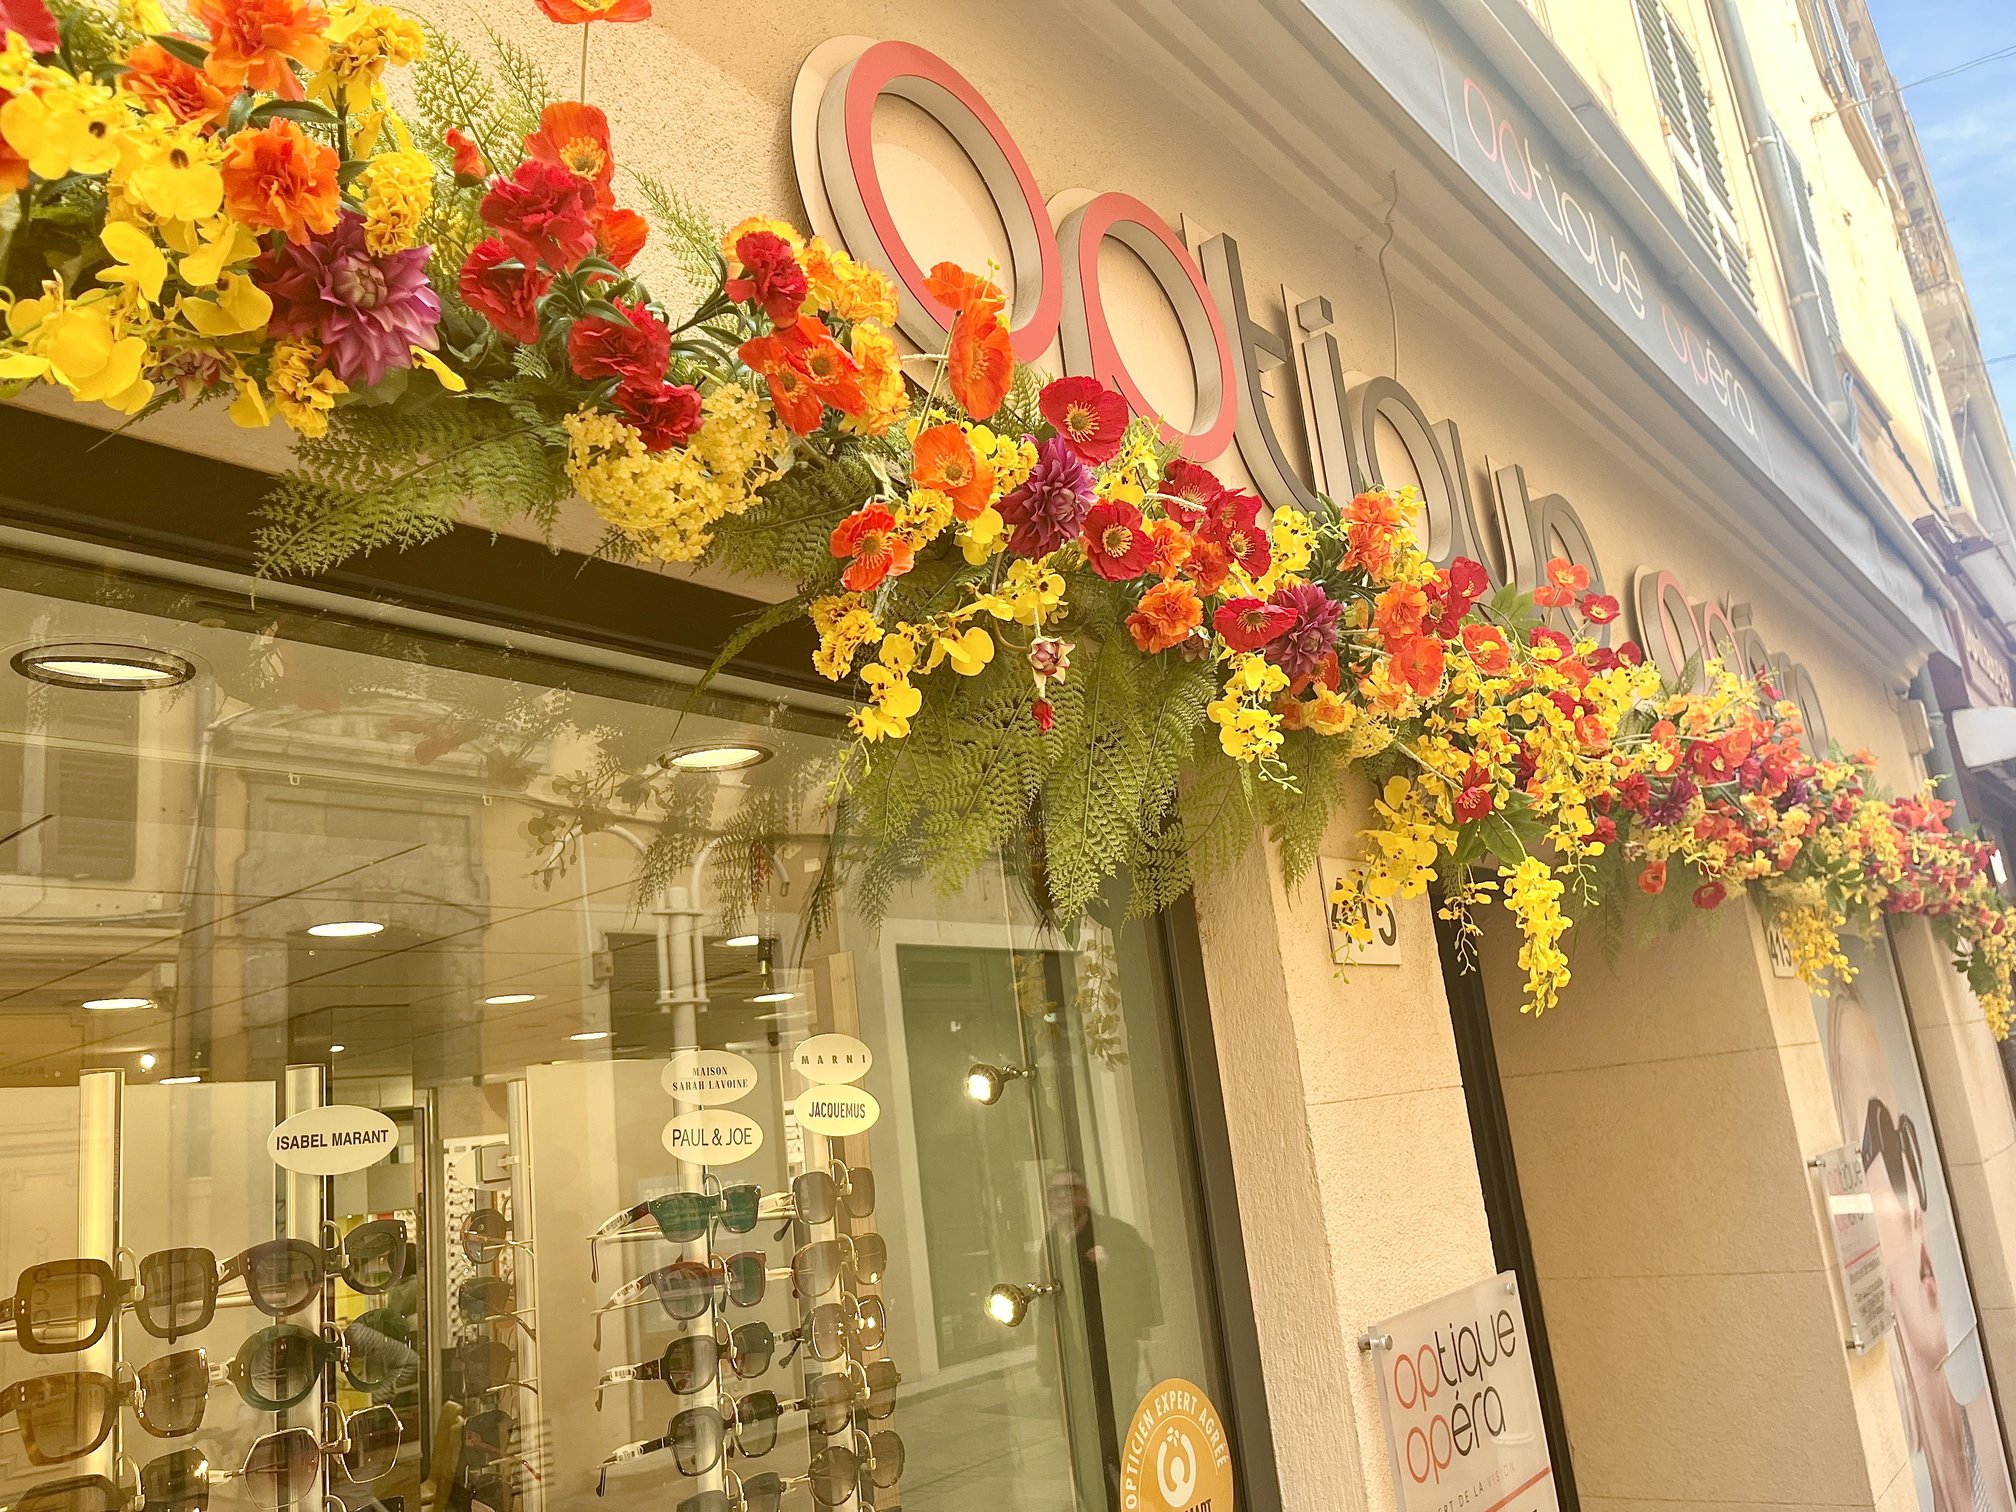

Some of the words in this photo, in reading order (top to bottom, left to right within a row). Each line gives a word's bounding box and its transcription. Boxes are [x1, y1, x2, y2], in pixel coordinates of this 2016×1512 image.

[1463, 78, 1646, 321] optique
[1661, 304, 1760, 441] opéra
[801, 1053, 867, 1065] MARNI
[692, 1066, 728, 1077] MAISON
[672, 1079, 705, 1092] SARAH
[709, 1078, 748, 1091] LAVOINE
[808, 1101, 866, 1119] JACQUEMUS
[276, 1133, 328, 1151] ISABEL
[331, 1129, 389, 1147] MARANT
[672, 1128, 708, 1147] PAUL
[711, 1127, 723, 1146] &
[726, 1127, 753, 1146] JOE
[1394, 1309, 1516, 1412] optique
[1406, 1386, 1506, 1485] opéra
[1125, 1408, 1155, 1510] OPTICIEN
[1153, 1390, 1198, 1418] EXPERT
[1198, 1407, 1229, 1469] AGRÉÉ
[1458, 1490, 1470, 1507] DE
[1474, 1482, 1485, 1497] LA
[1487, 1463, 1516, 1487] VISION
